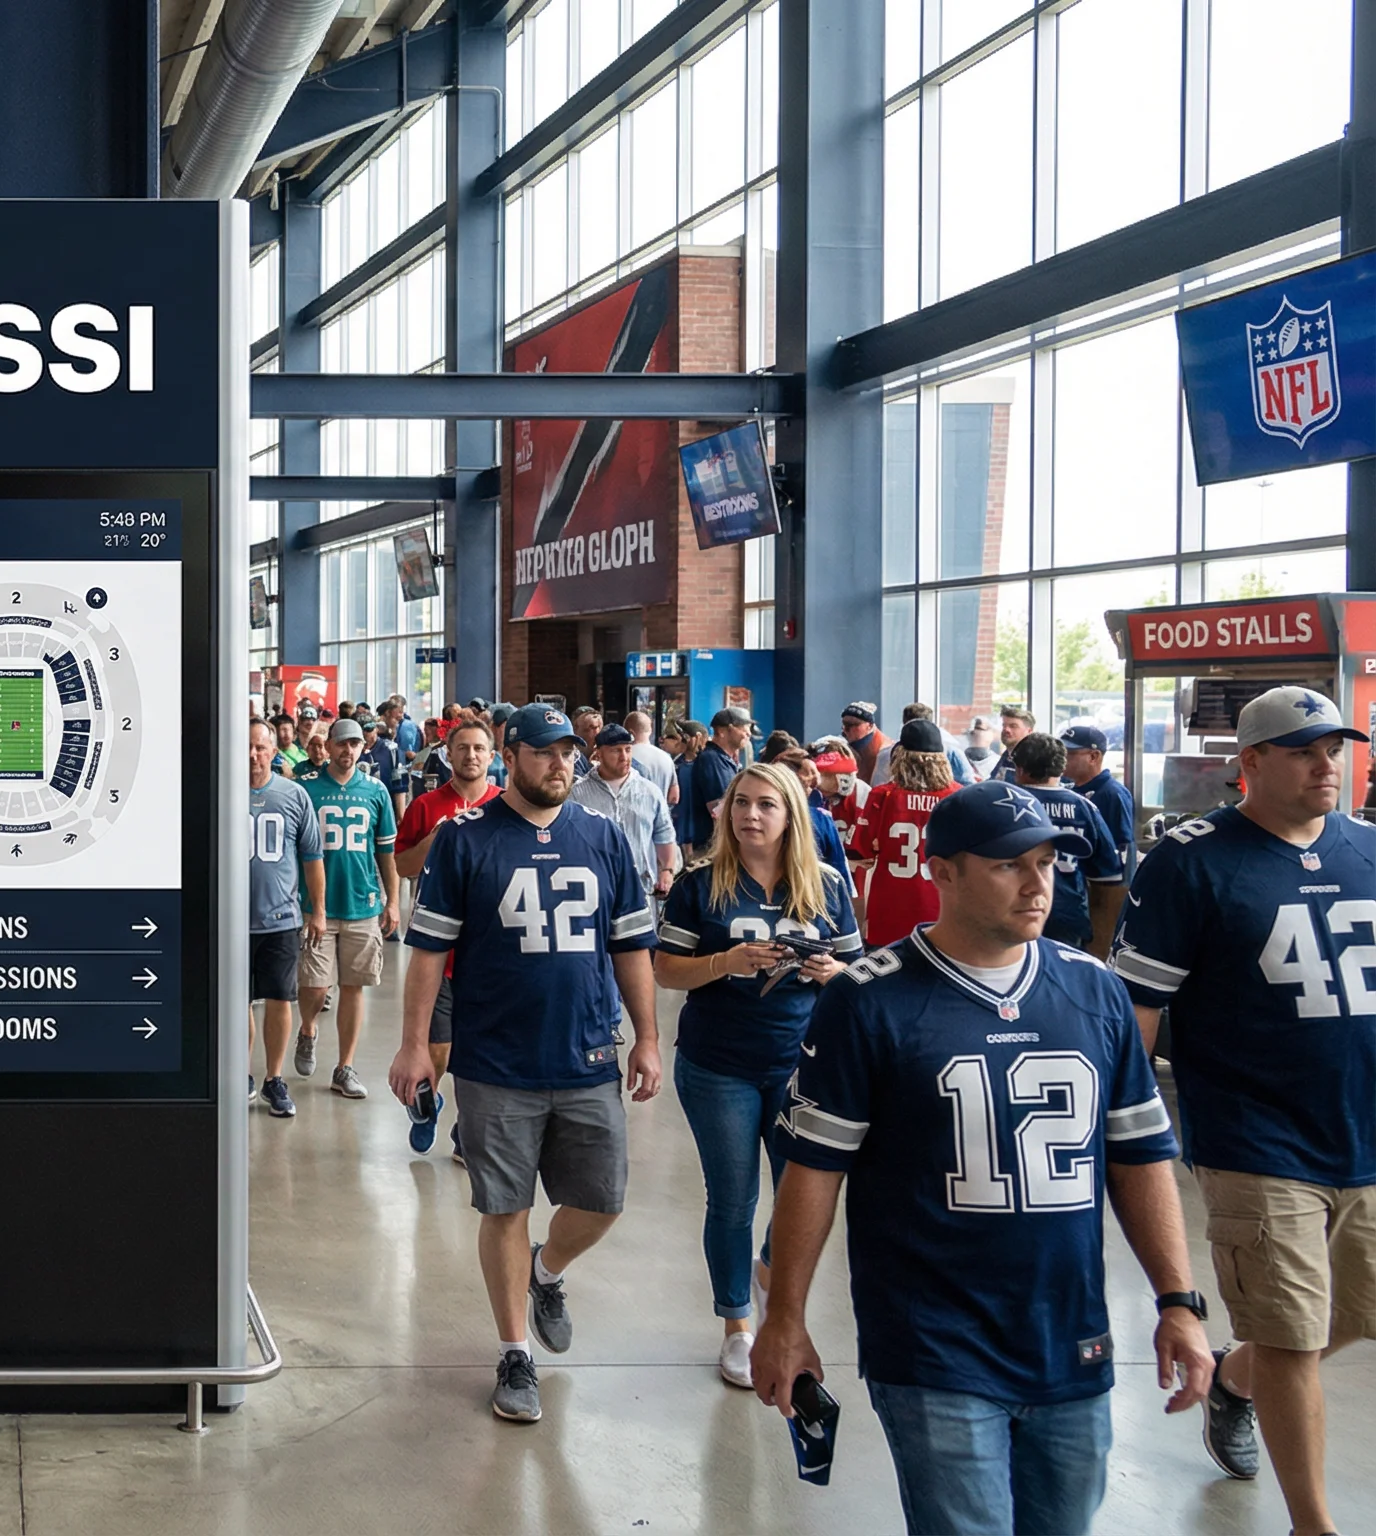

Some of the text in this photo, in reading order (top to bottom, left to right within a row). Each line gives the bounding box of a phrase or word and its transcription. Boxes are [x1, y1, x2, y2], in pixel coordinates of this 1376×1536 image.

[1261, 359, 1331, 425] NFL
[99, 511, 166, 527] 5:48 PM
[589, 519, 656, 573] GLOPH
[11, 591, 22, 604] 2
[109, 648, 120, 661] 3
[1144, 612, 1313, 650] FOOD STALLS
[122, 718, 132, 731] 2
[318, 805, 371, 853] 62
[498, 866, 600, 954] 42
[1258, 899, 1376, 1019] 42
[936, 1050, 1099, 1214] 12
